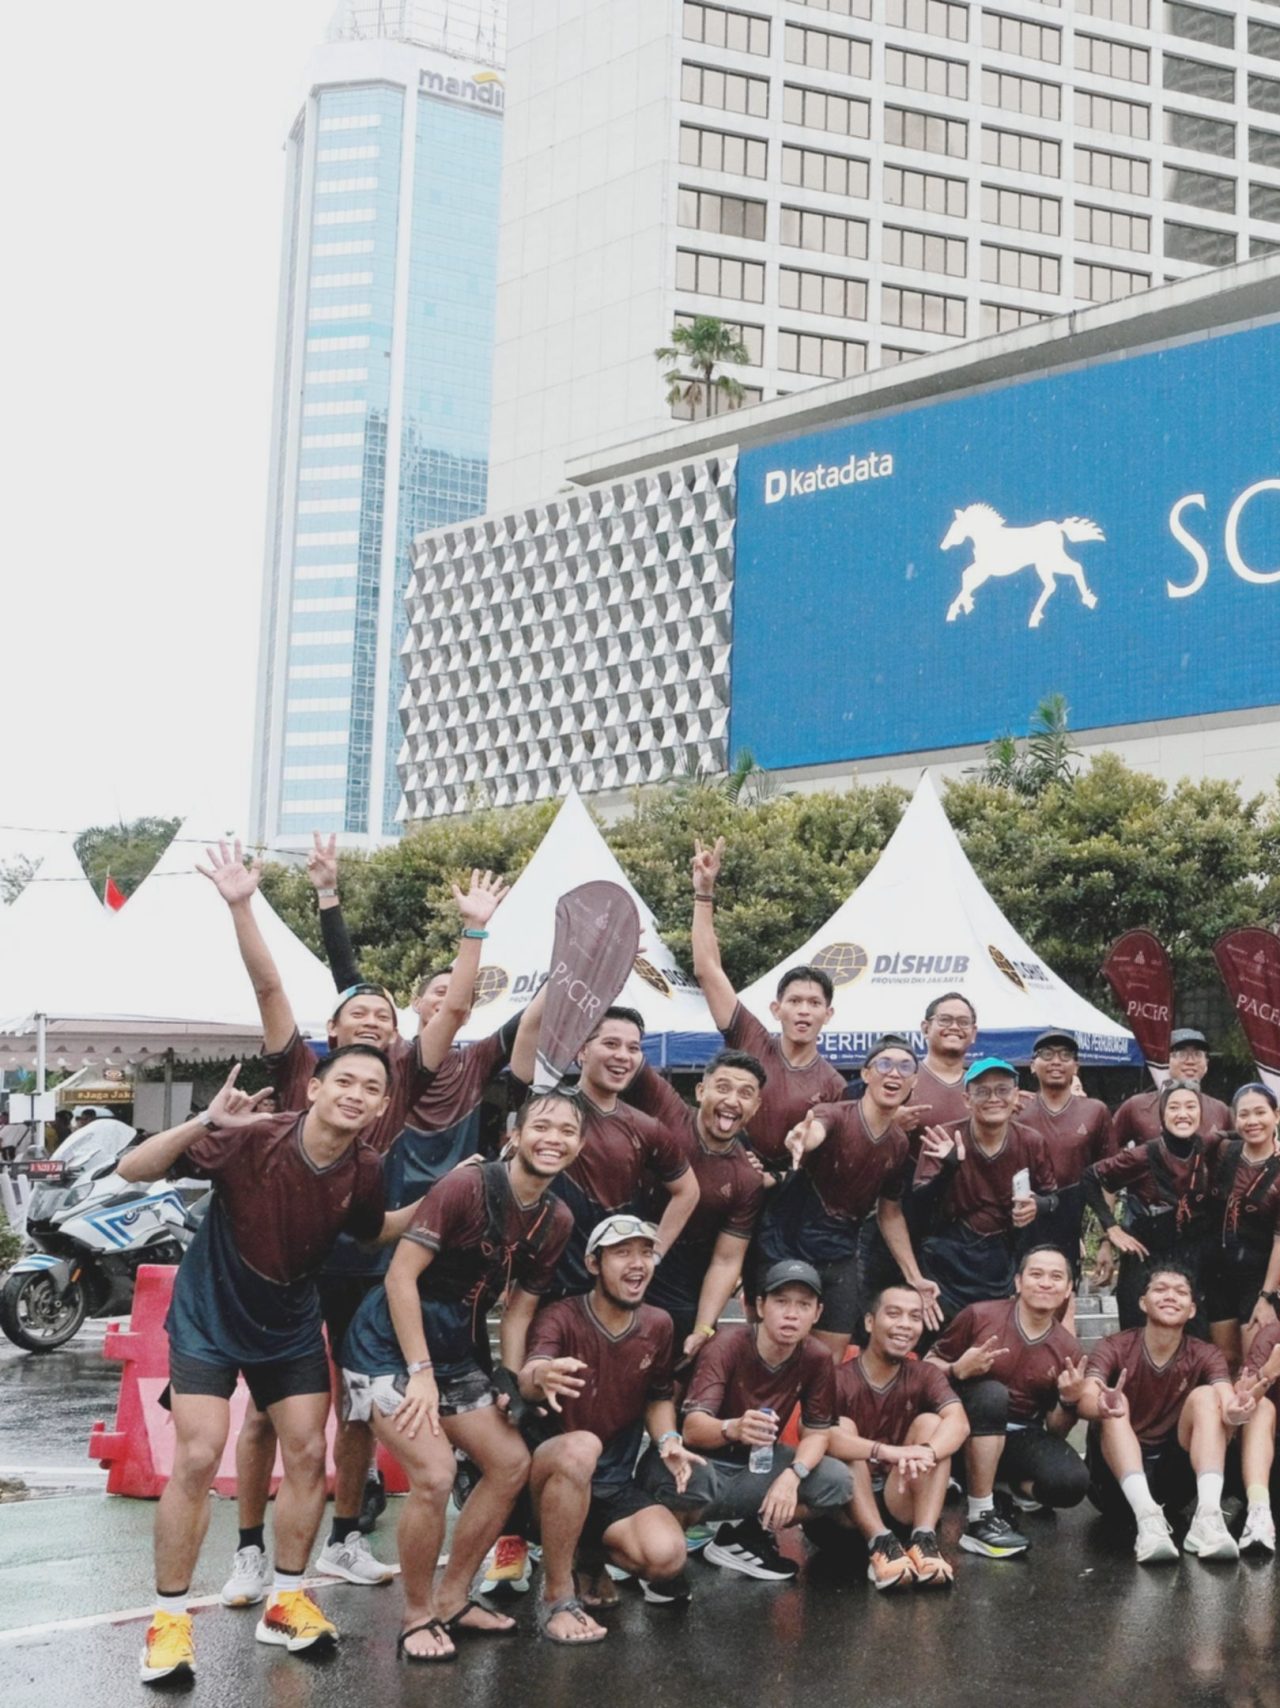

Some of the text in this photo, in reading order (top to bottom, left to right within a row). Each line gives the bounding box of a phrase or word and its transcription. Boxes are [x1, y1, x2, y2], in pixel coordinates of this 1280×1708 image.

[418, 68, 505, 110] mandi
[790, 452, 893, 496] katadata
[873, 952, 970, 974] DISHUB
